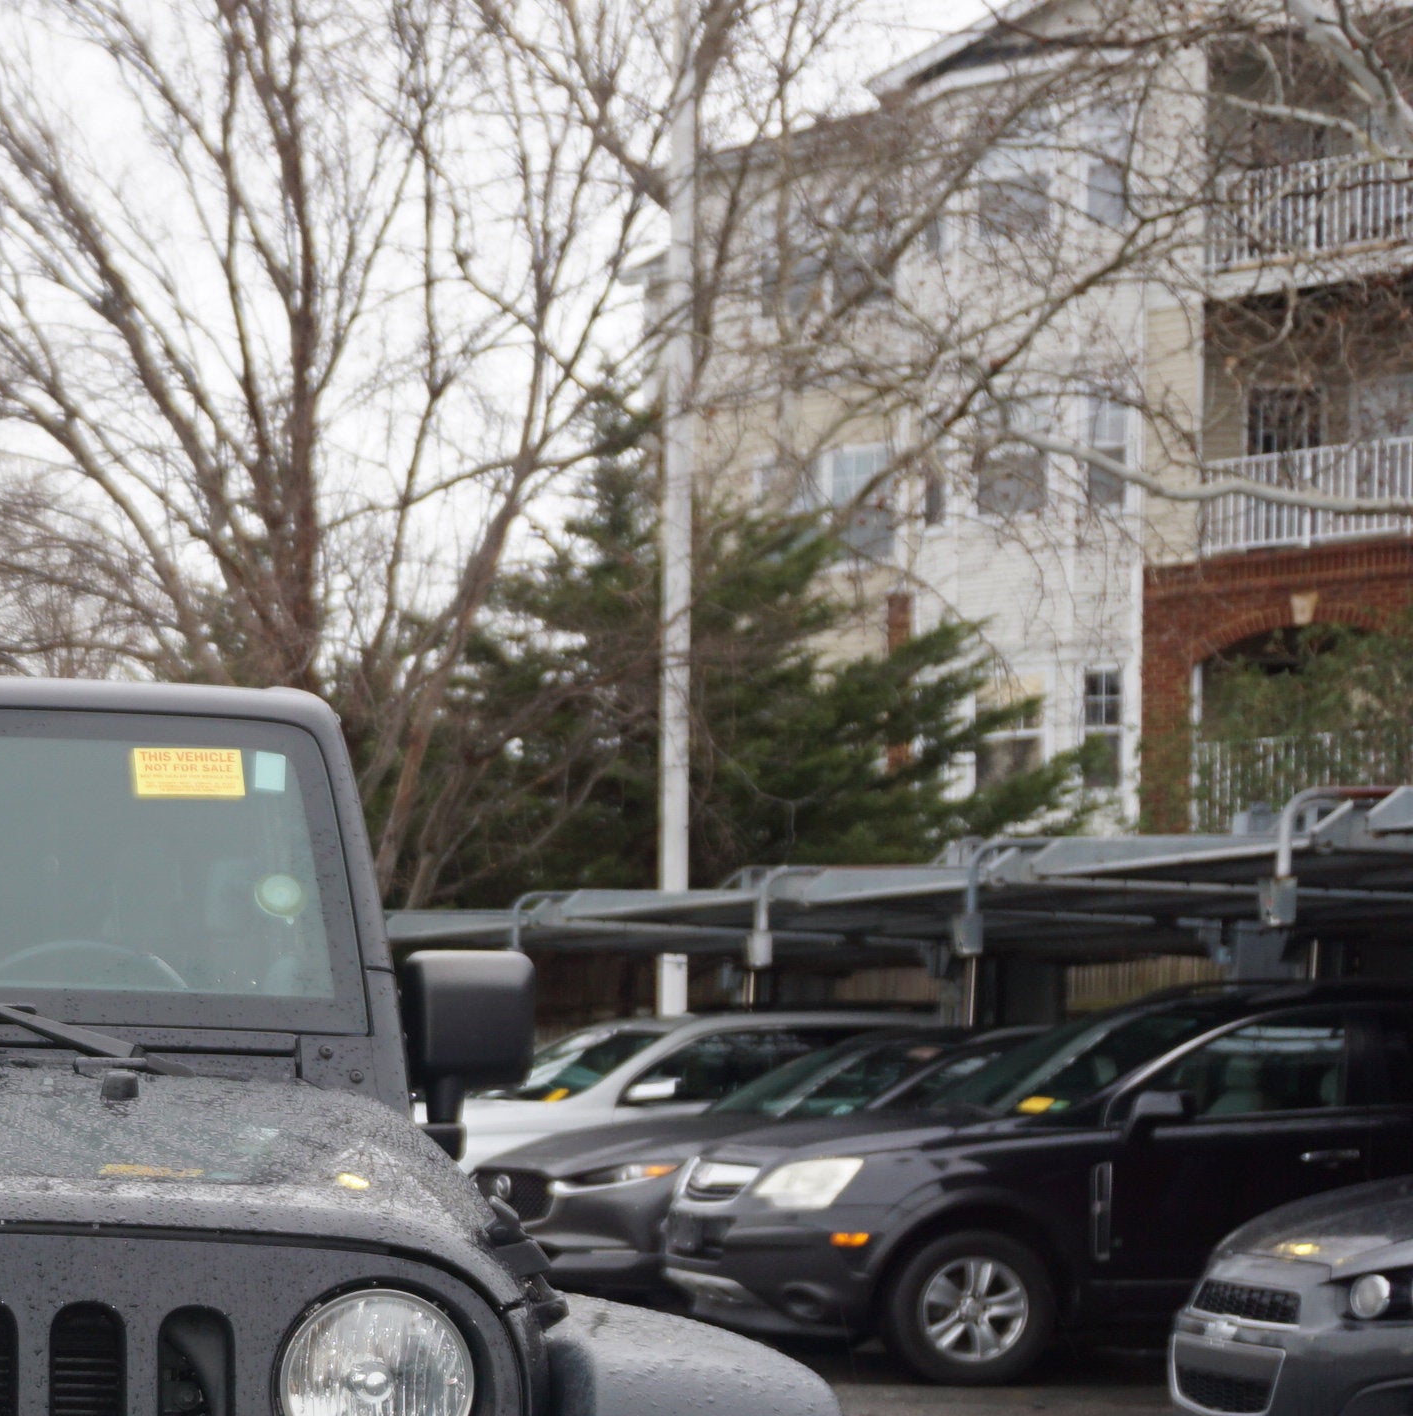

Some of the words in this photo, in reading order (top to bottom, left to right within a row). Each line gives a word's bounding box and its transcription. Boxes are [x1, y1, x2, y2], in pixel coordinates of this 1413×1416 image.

[139, 751, 171, 762] THIS
[176, 751, 236, 763] VEHICLE
[144, 763, 168, 772] NOT
[173, 764, 198, 772] FOR
[203, 764, 234, 773] SALE
